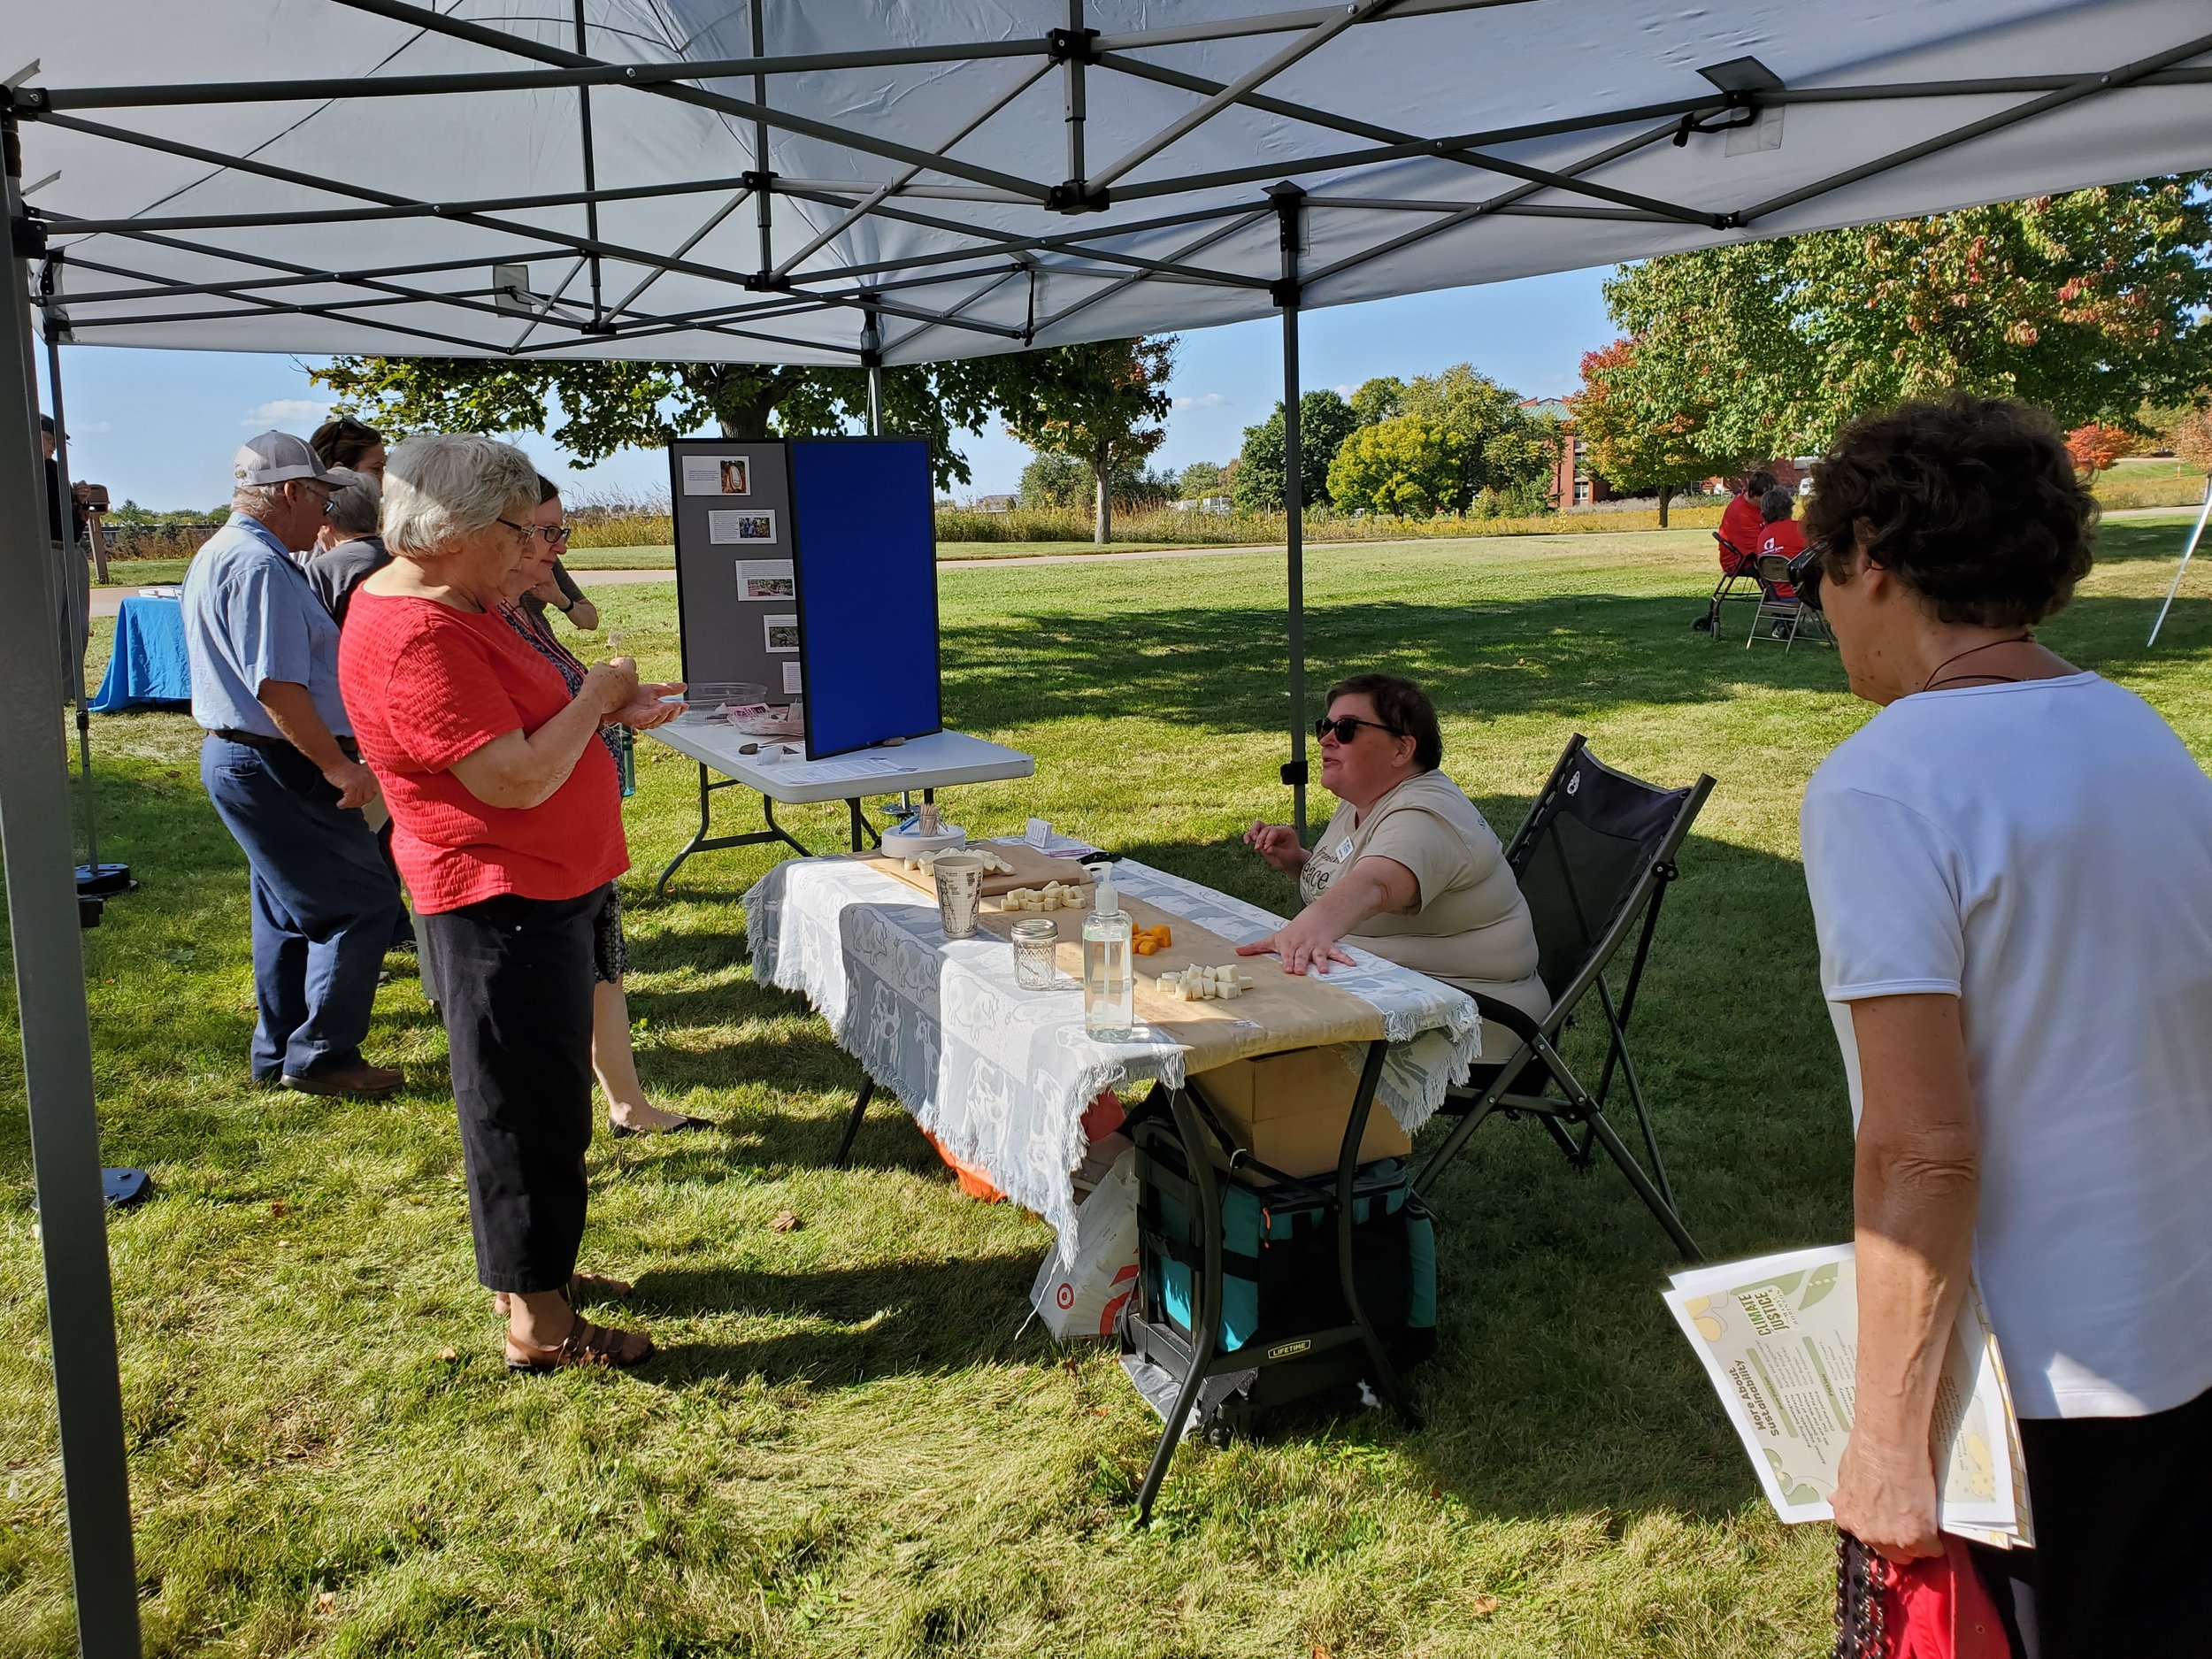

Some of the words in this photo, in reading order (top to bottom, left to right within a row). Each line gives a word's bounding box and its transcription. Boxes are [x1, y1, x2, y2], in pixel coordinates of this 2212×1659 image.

[1302, 863, 1330, 890] eace
[1738, 1294, 1771, 1336] CLIMATE
[1755, 1290, 1789, 1333] JUSTICE
[1272, 1342, 1306, 1356] LIFETIME
[1729, 1367, 1750, 1400] About
[1735, 1360, 1779, 1437] Sustainability
[1823, 1374, 1833, 1396] Fiction
[1747, 1402, 1766, 1431] More
